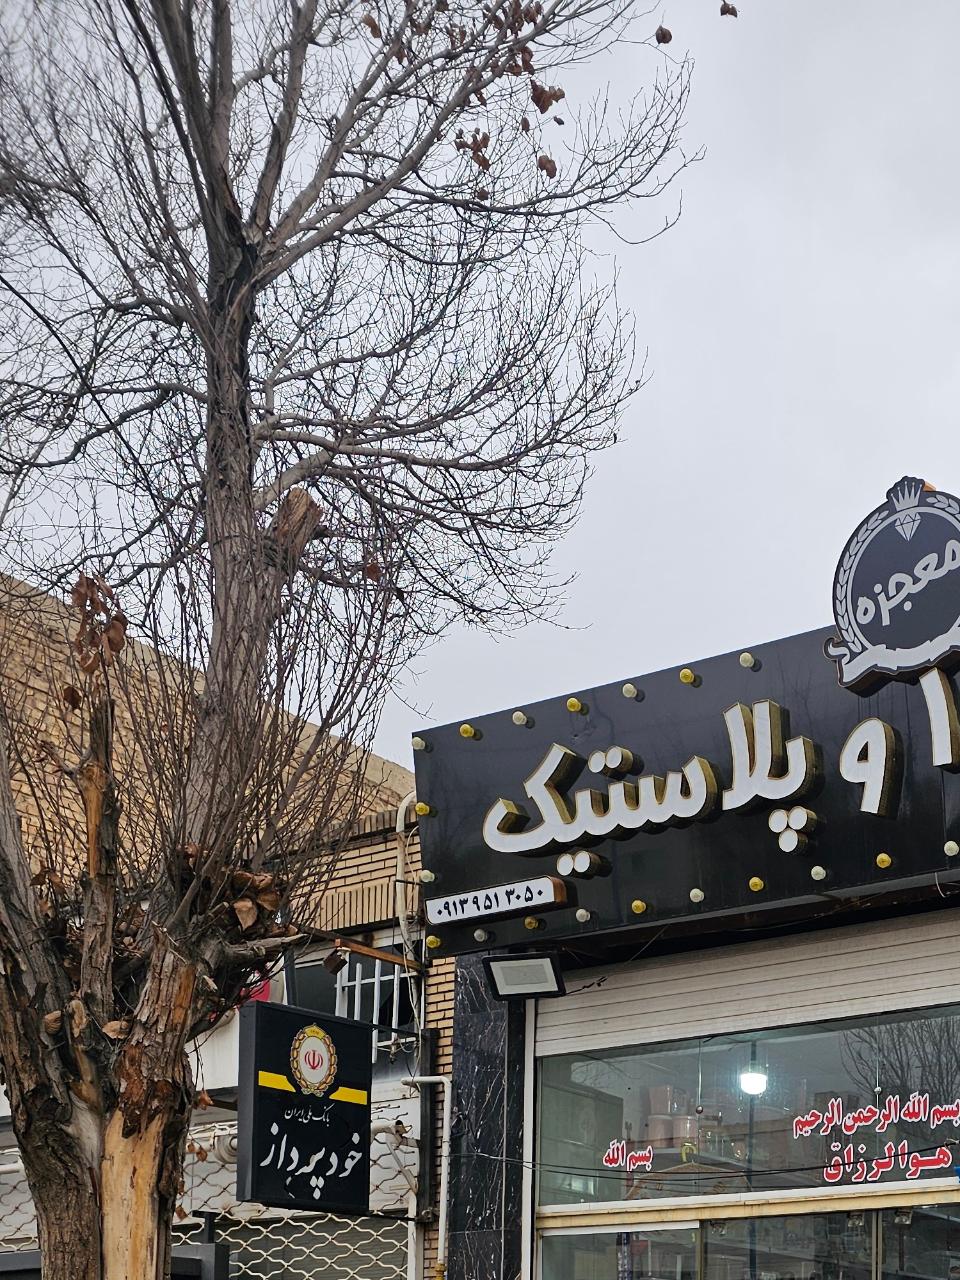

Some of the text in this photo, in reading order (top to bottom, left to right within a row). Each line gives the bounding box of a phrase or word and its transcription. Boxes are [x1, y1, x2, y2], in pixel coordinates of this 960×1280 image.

[840, 717, 894, 814] و
[483, 699, 814, 876] پلاستیک
[284, 1108, 304, 1121] ایران
[312, 1103, 336, 1127] بانک
[793, 1098, 842, 1139] الرحیم
[842, 1095, 900, 1136] الرحمن
[901, 1091, 930, 1122] الله
[603, 1139, 653, 1174] بسم الله
